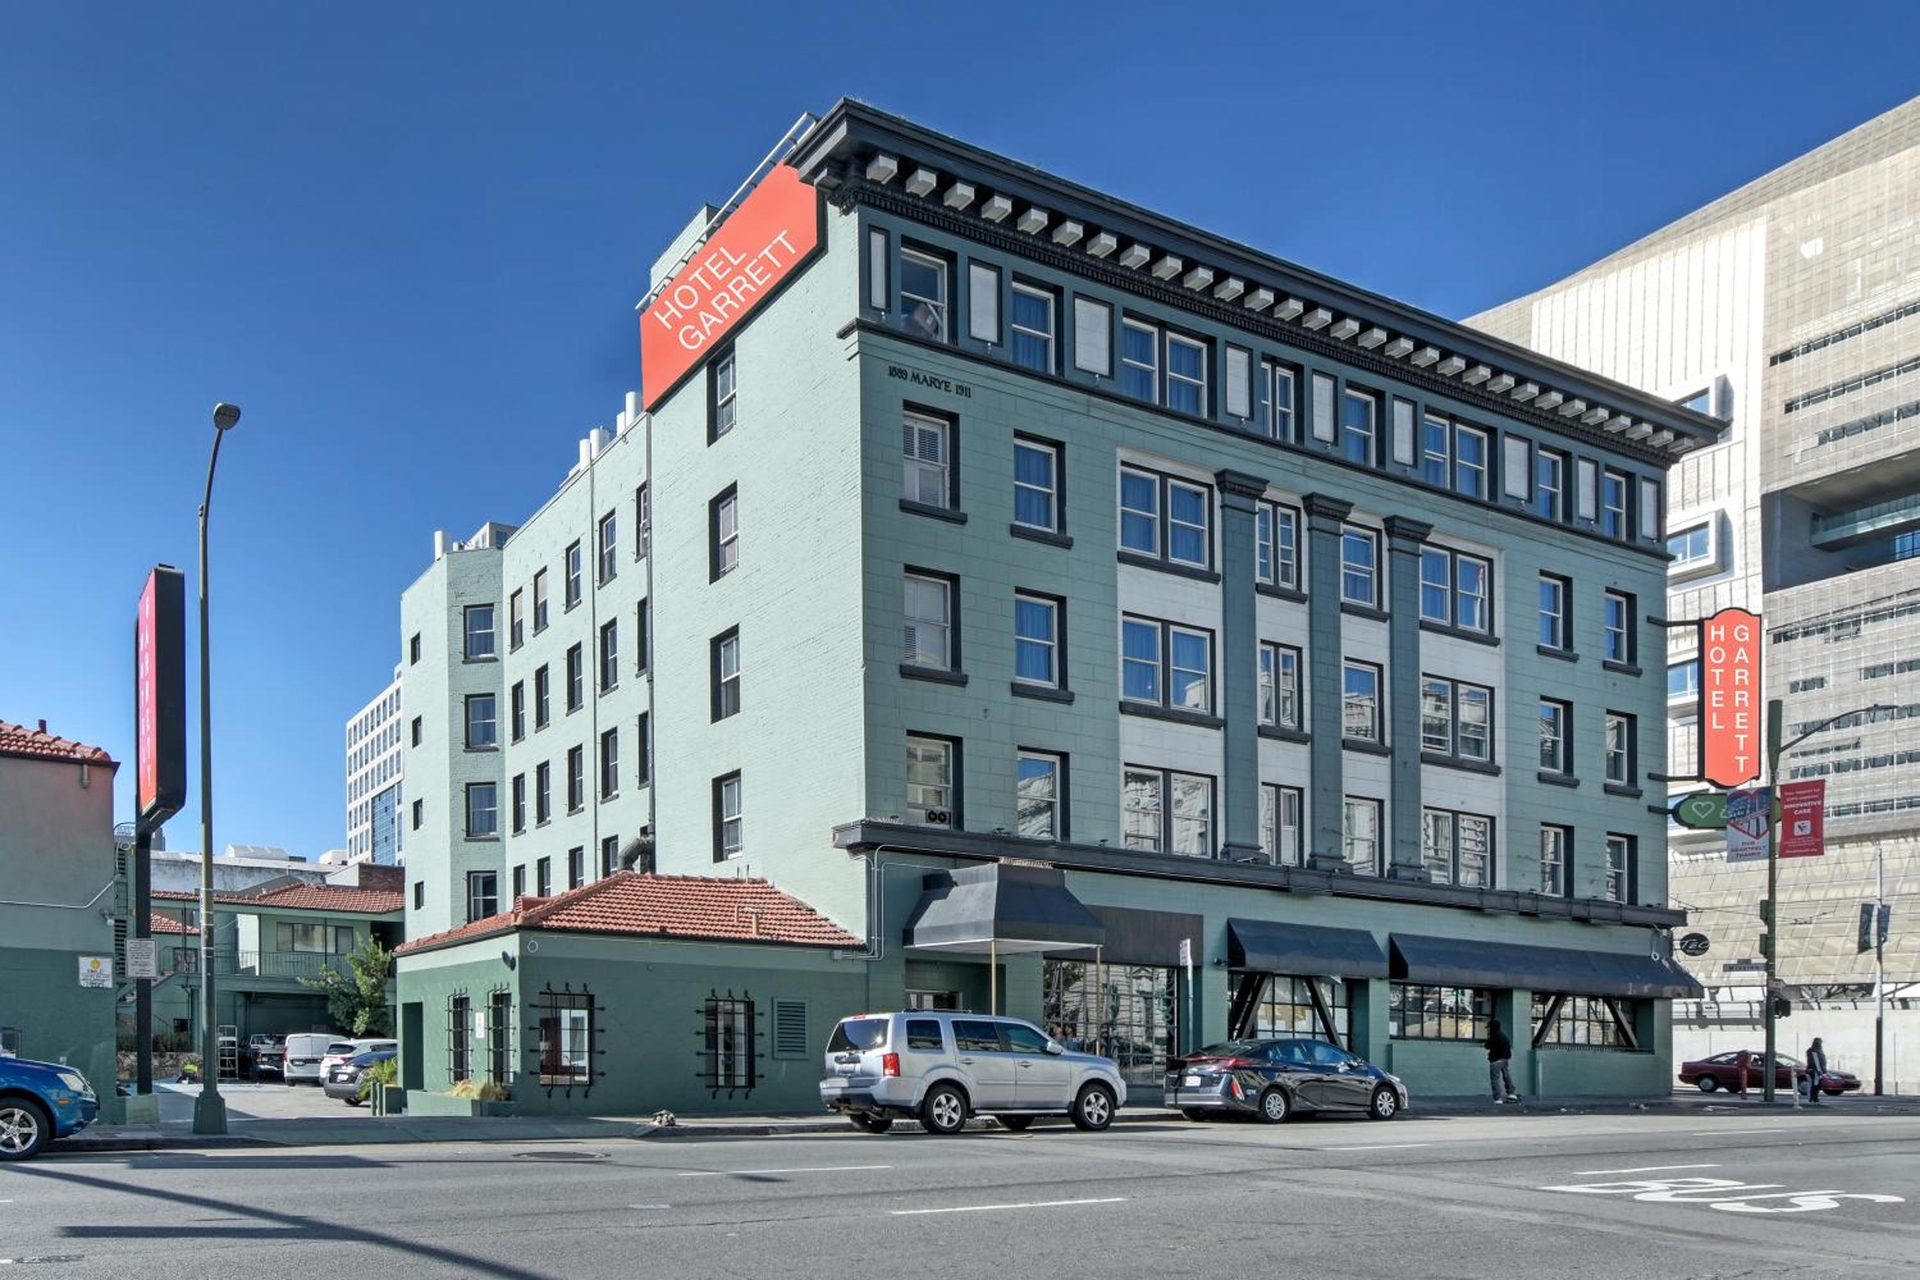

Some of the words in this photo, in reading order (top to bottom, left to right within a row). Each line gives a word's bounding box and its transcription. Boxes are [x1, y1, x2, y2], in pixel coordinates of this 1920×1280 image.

[653, 246, 747, 330] HOTEL
[678, 229, 797, 350] GARRETT
[910, 372, 952, 392] MARYE
[955, 384, 972, 398] 1911
[1709, 624, 1726, 730] HOTEL
[1734, 624, 1750, 774] GARRETT
[1537, 1177, 1906, 1213] BUS
